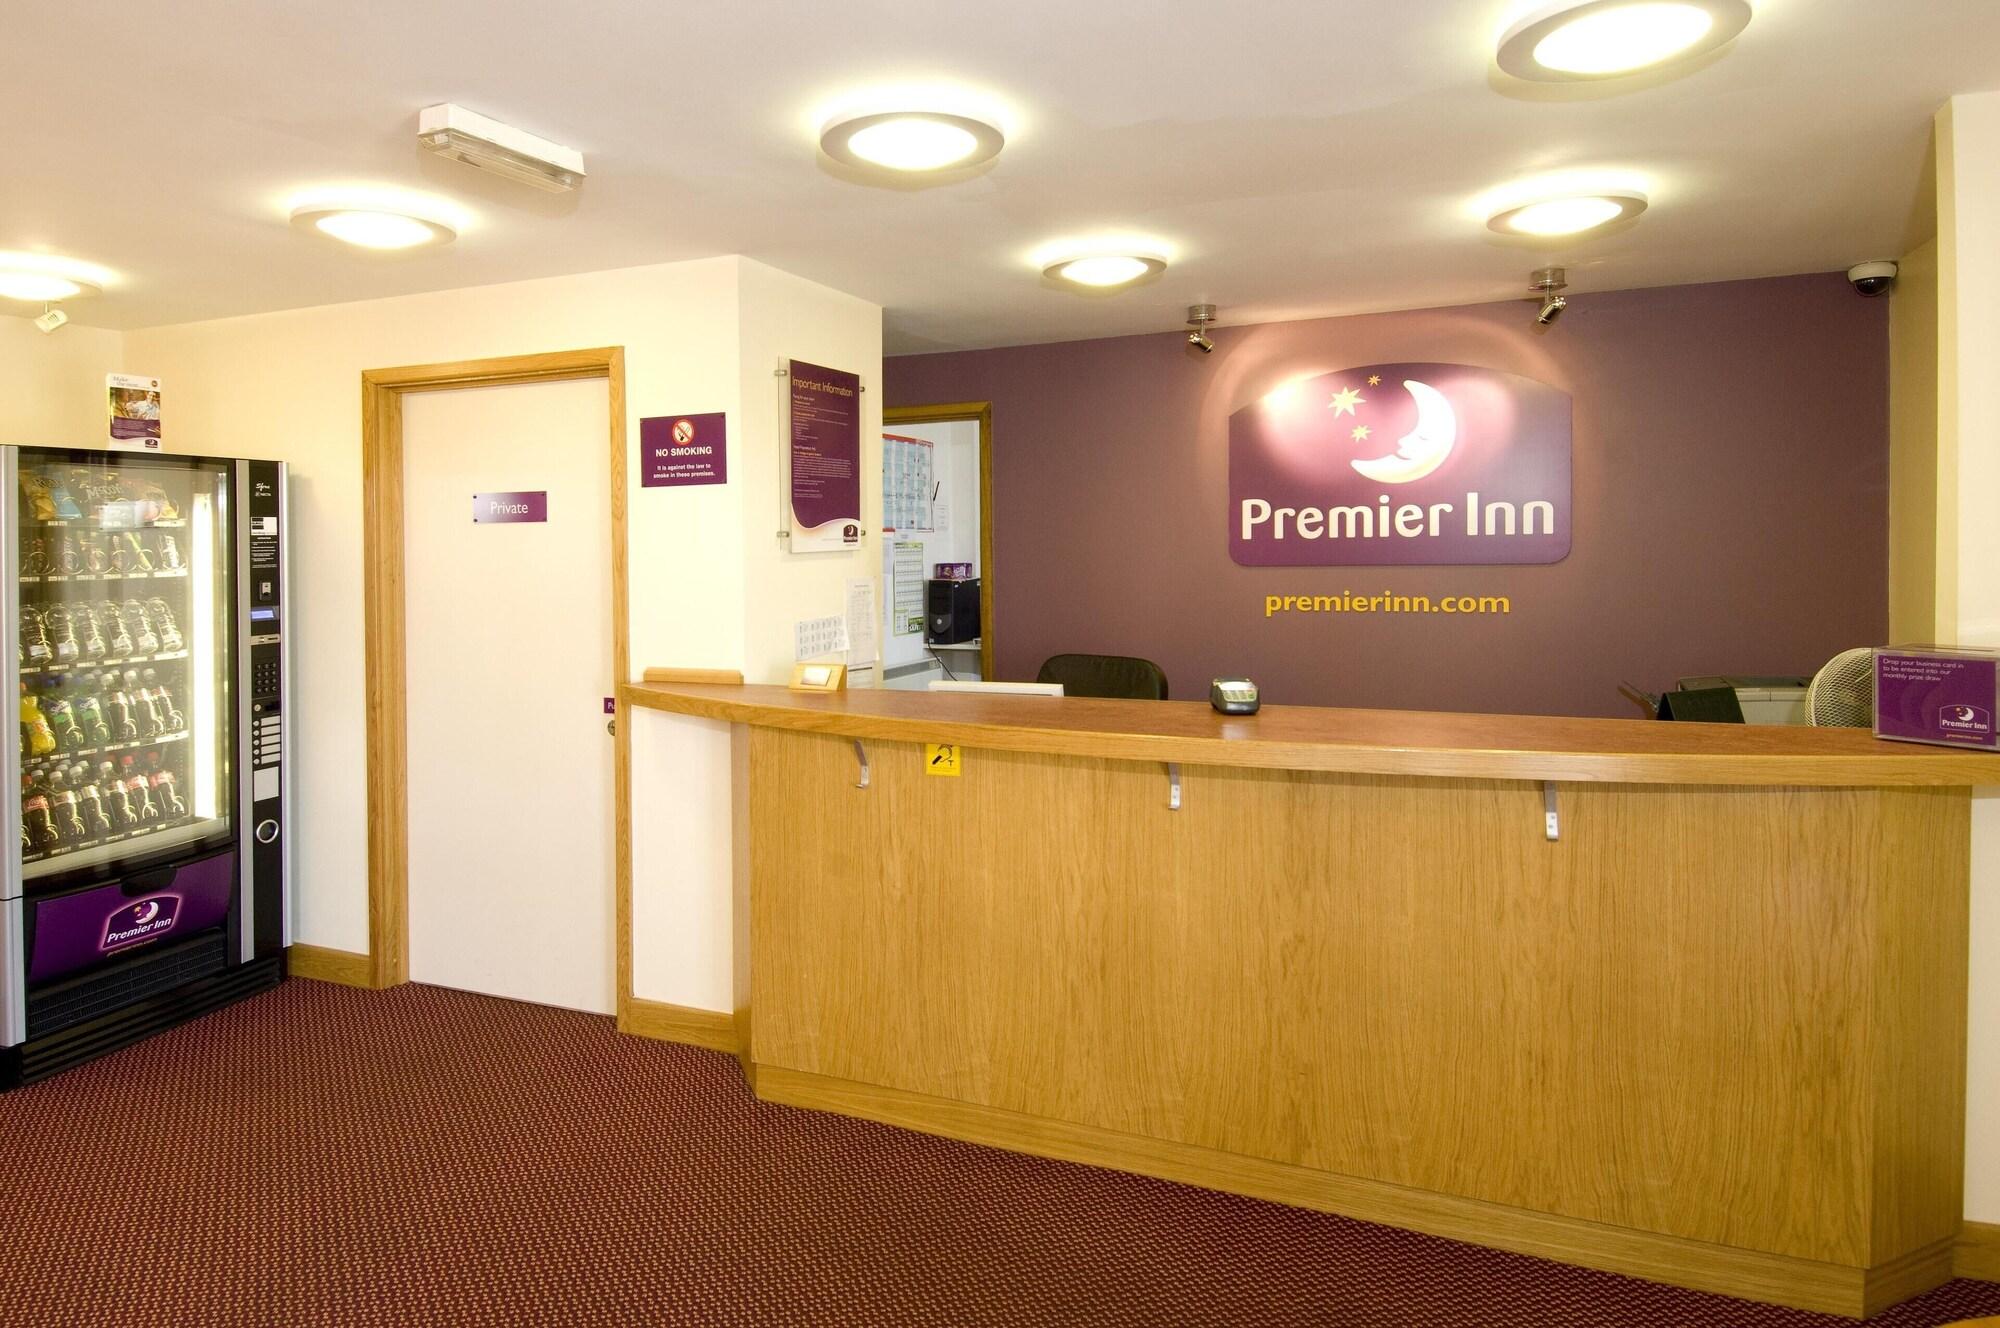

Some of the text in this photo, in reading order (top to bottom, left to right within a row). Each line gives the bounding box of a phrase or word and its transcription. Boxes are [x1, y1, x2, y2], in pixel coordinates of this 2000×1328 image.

[792, 376, 821, 391] Important
[822, 381, 853, 397] Information
[655, 446, 713, 457] NO SMOKING
[490, 501, 529, 515] Private
[1241, 491, 1554, 540] Premier Inn
[1265, 590, 1511, 617] premierinn.com
[1883, 658, 1900, 666] Drop
[1942, 720, 1973, 728] Premier
[107, 918, 172, 943] Premier Inn
